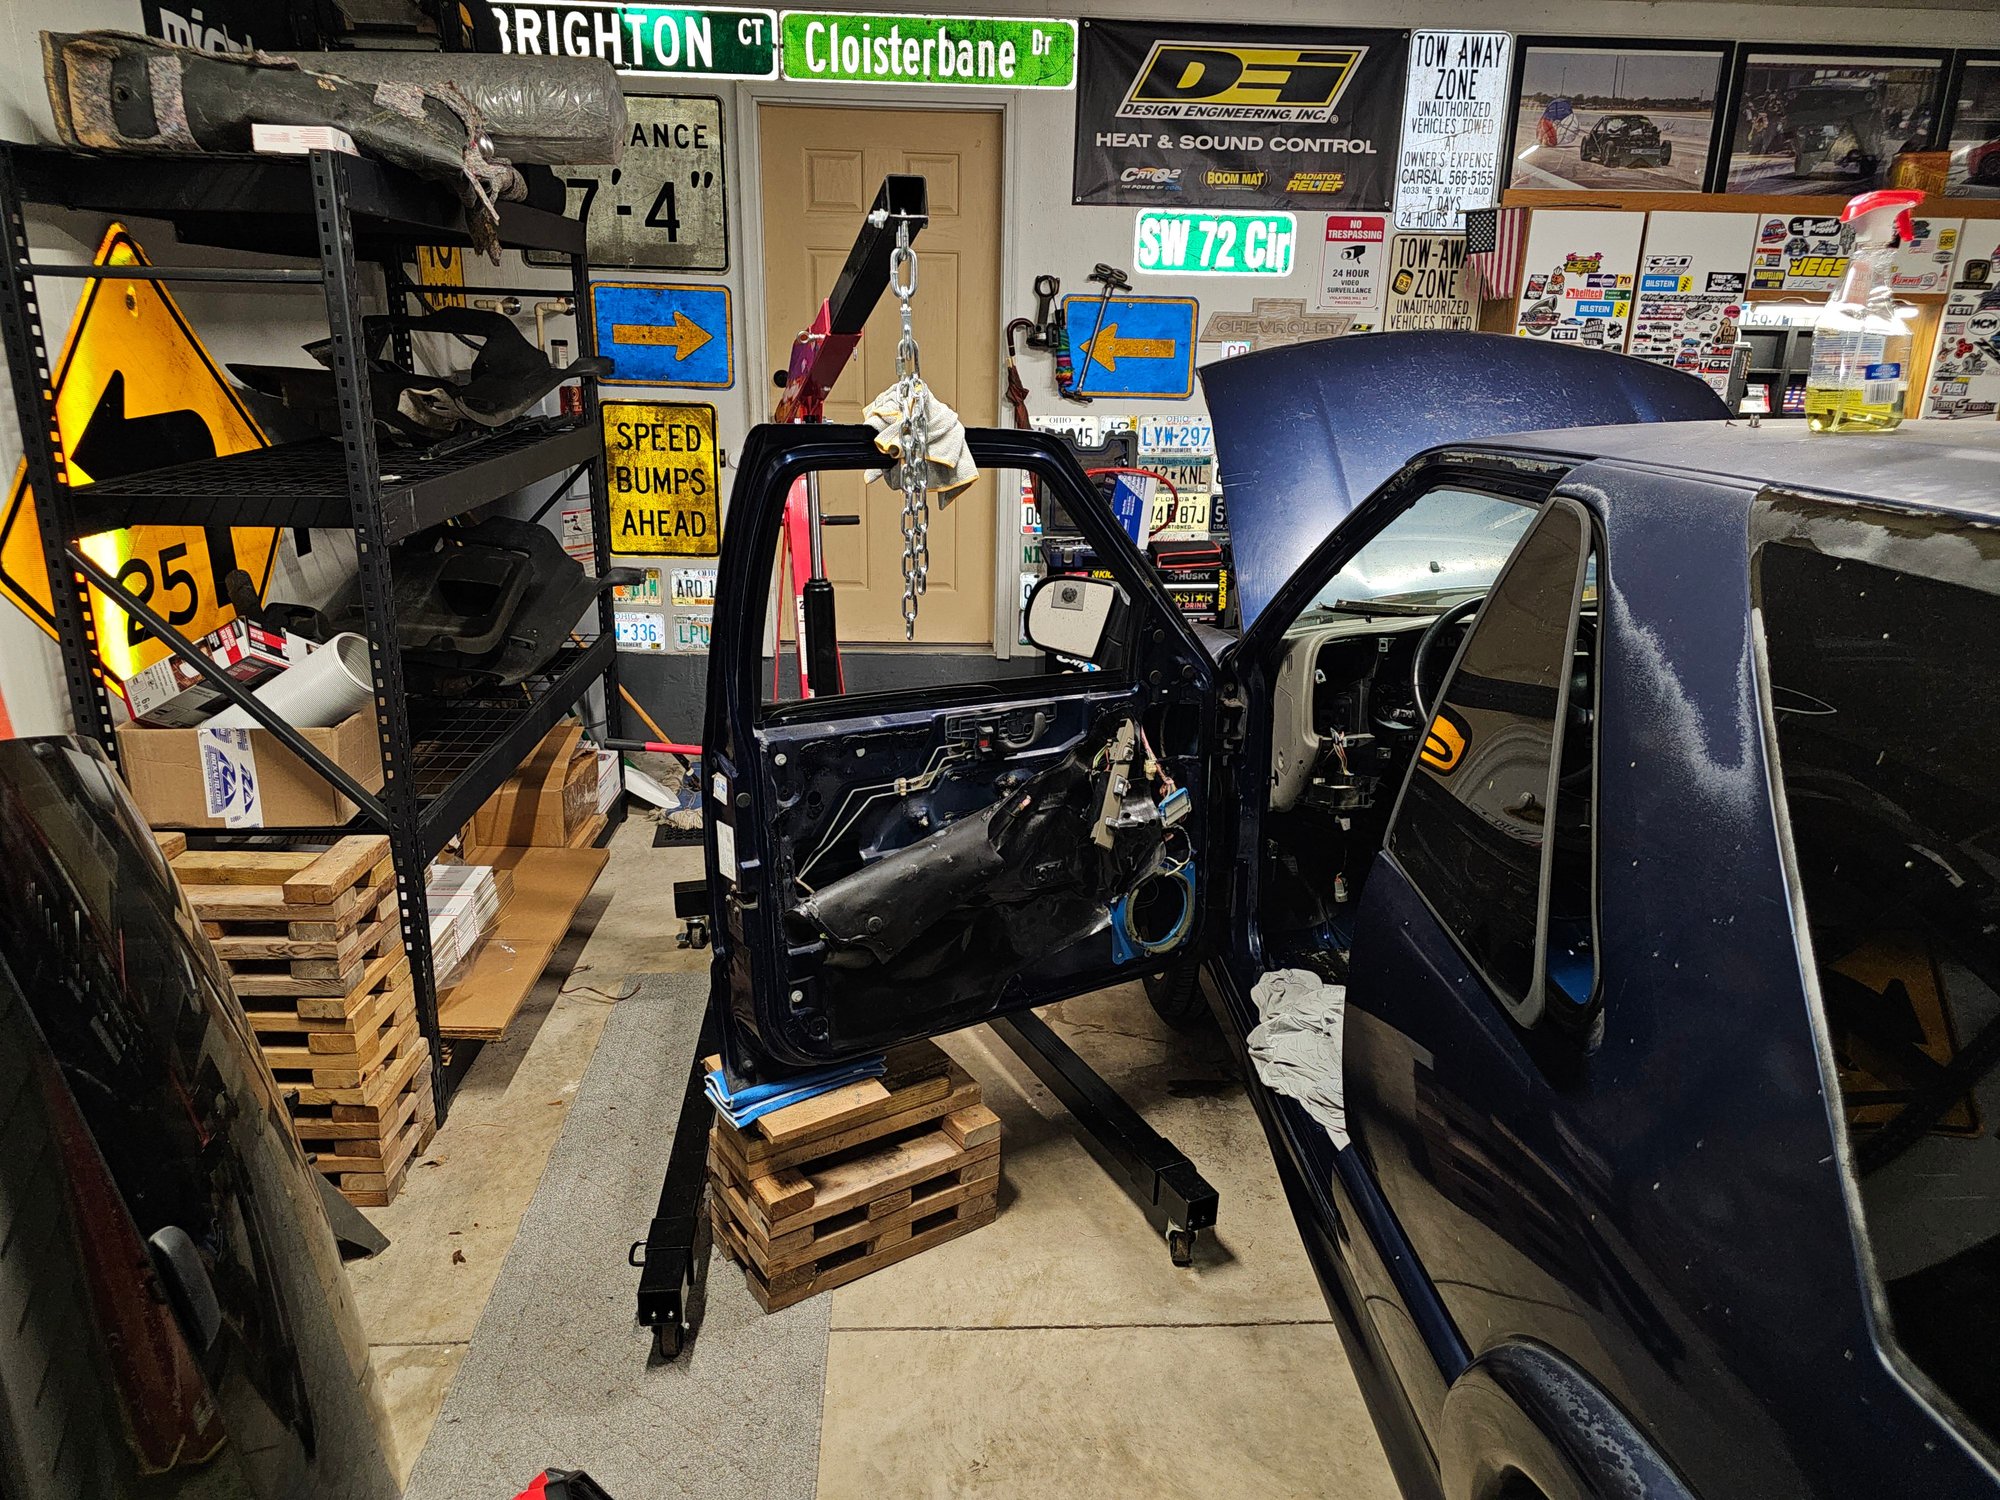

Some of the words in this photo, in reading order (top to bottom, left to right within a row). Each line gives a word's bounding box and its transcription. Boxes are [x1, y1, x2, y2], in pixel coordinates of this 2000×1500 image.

[737, 18, 764, 46] CT
[805, 21, 1016, 79] Cloisterbane
[1032, 29, 1052, 56] Dr
[1417, 35, 1449, 67] TOW
[1458, 36, 1505, 68] AWAY
[1435, 69, 1479, 100] ZONE
[1121, 103, 1184, 116] DESIGN
[1185, 105, 1293, 120] ENGINEERING,
[1295, 109, 1327, 121] INC.
[1417, 101, 1491, 117] UNAUTHORIZED
[1412, 118, 1456, 134] VEHICLES
[1462, 119, 1494, 135] TOWED
[624, 123, 708, 149] ANCE
[1096, 133, 1152, 148] HEAT
[1157, 134, 1174, 149] &
[1179, 134, 1264, 151] SOUND
[1269, 137, 1377, 154] CONTROL
[1444, 135, 1456, 151] AT
[1404, 151, 1445, 167] OWNER'S
[1450, 152, 1494, 168] EXPENSE
[1207, 172, 1239, 185] BOOM
[1241, 172, 1264, 185] MAT
[1294, 172, 1342, 181] RADIATOR
[1401, 169, 1444, 185] CARSAL
[1449, 170, 1493, 186] 566-5155
[1286, 180, 1344, 192] RELIEF
[1402, 186, 1420, 194] 4033
[1435, 187, 1440, 195] 9
[1443, 187, 1453, 195] AV
[1455, 187, 1465, 195] FT
[1468, 187, 1489, 196] LAUD
[1427, 196, 1432, 210] 7
[1437, 196, 1461, 211] DAYS
[1350, 220, 1362, 229] NO
[1400, 212, 1412, 227] 24
[1417, 212, 1447, 227] HOURS
[1139, 217, 1190, 267] SW
[1199, 220, 1238, 268] 72
[1245, 221, 1291, 270] Cir
[1328, 230, 1382, 240] TRESPASSING
[1646, 255, 1692, 267] 1320
[1789, 257, 1850, 276] JEGS
[1332, 269, 1344, 278] 24
[1346, 269, 1369, 278] HOUR
[1619, 276, 1631, 285] 70
[1327, 286, 1372, 294] SURVEILLANCE
[1398, 277, 1409, 288] 93
[1415, 269, 1458, 299] ZONE
[1645, 279, 1675, 288] BILSTEIN
[1396, 300, 1469, 315] UNAUTHORIZED
[1579, 304, 1610, 313] BILSTEIN
[1949, 306, 1972, 315] YETI
[1217, 320, 1341, 334] CHEVROLET
[1390, 314, 1435, 330] VEHICLES
[1440, 315, 1472, 331] TOWED
[1970, 319, 1998, 329] MCM
[1552, 330, 1576, 338] YETI
[617, 422, 701, 452] SPEED
[1143, 426, 1174, 447] LYW
[1180, 427, 1211, 447] 297
[616, 466, 706, 496] BUMPS
[1180, 465, 1206, 485] KNL
[1180, 505, 1206, 524] 87J
[621, 509, 707, 538] AHEAD
[115, 542, 199, 648] 25
[677, 579, 703, 598] ARD
[631, 623, 657, 642] 336
